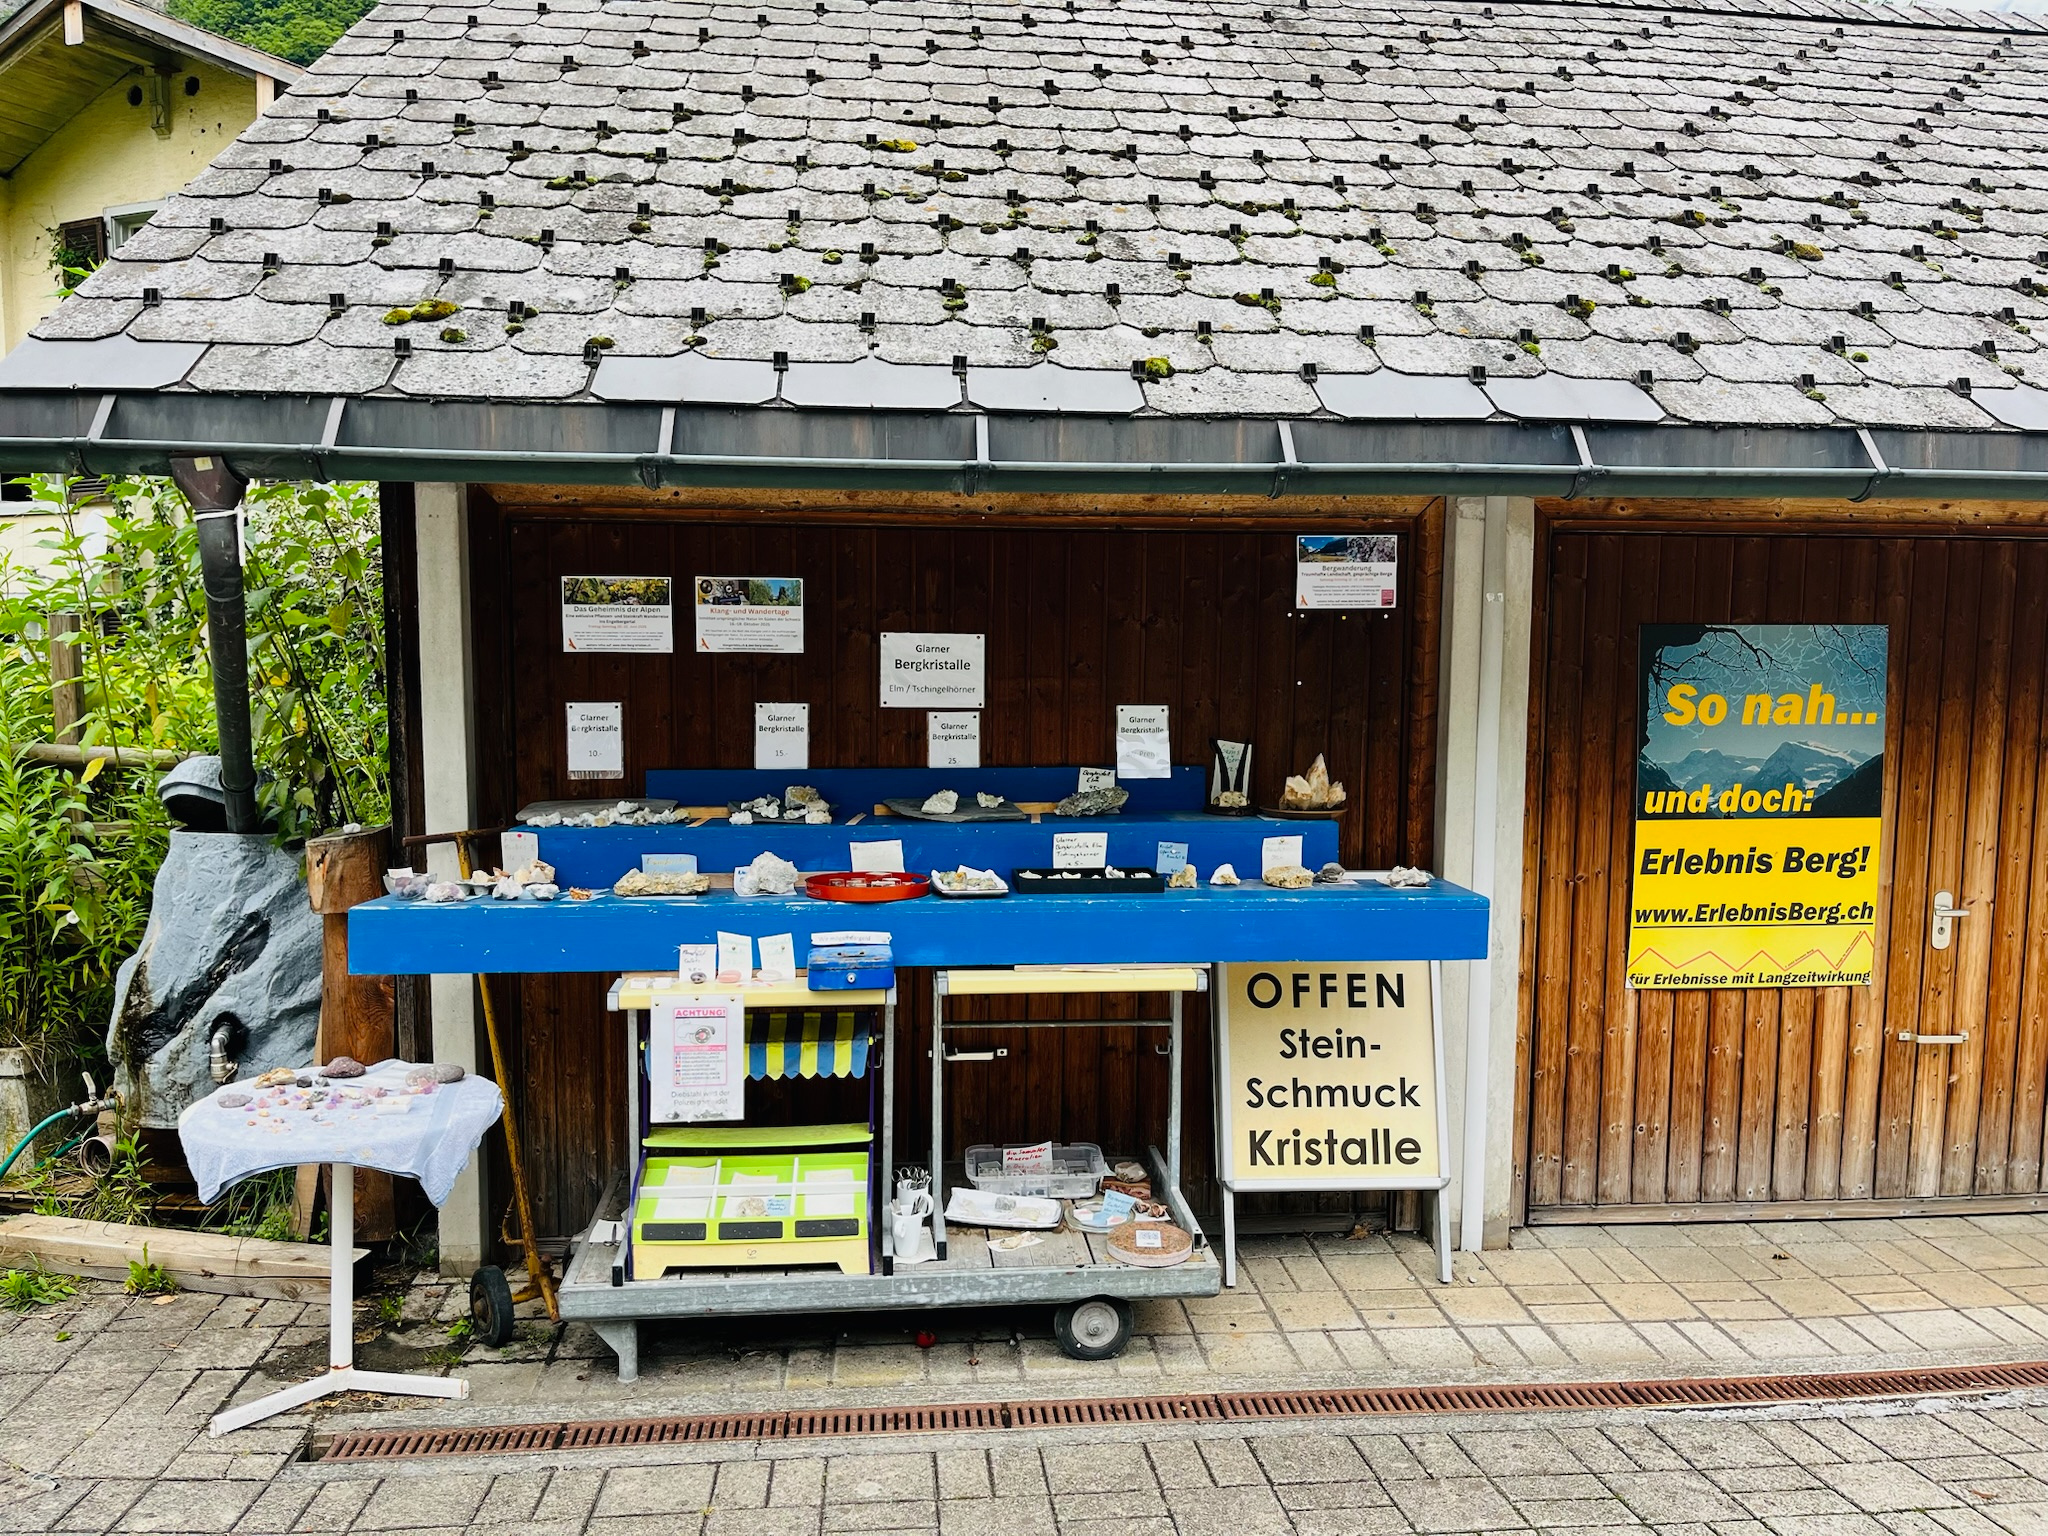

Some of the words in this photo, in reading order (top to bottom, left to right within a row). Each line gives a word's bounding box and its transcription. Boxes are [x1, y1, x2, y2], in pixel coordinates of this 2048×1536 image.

[916, 644, 950, 653] Glarner
[895, 659, 971, 672] Bergkristalle
[1663, 684, 1728, 726] So
[1742, 684, 1878, 726] nah...
[1644, 784, 1711, 814] und
[1718, 783, 1815, 813] doch:
[1640, 847, 1773, 875] Erlebnis
[1783, 846, 1870, 878] Berg!
[1635, 902, 1874, 924] www.ErlebnisBerg.ch
[1247, 972, 1405, 1008] OFFEN
[1630, 973, 1650, 985] für
[1654, 972, 1728, 984] Erlebnisse
[1732, 972, 1754, 984] mit
[1758, 970, 1871, 985] Langzeitwirkung
[1280, 1028, 1381, 1059] Stein-
[1246, 1077, 1421, 1108] Schmuck
[1250, 1128, 1422, 1166] Kristalle
